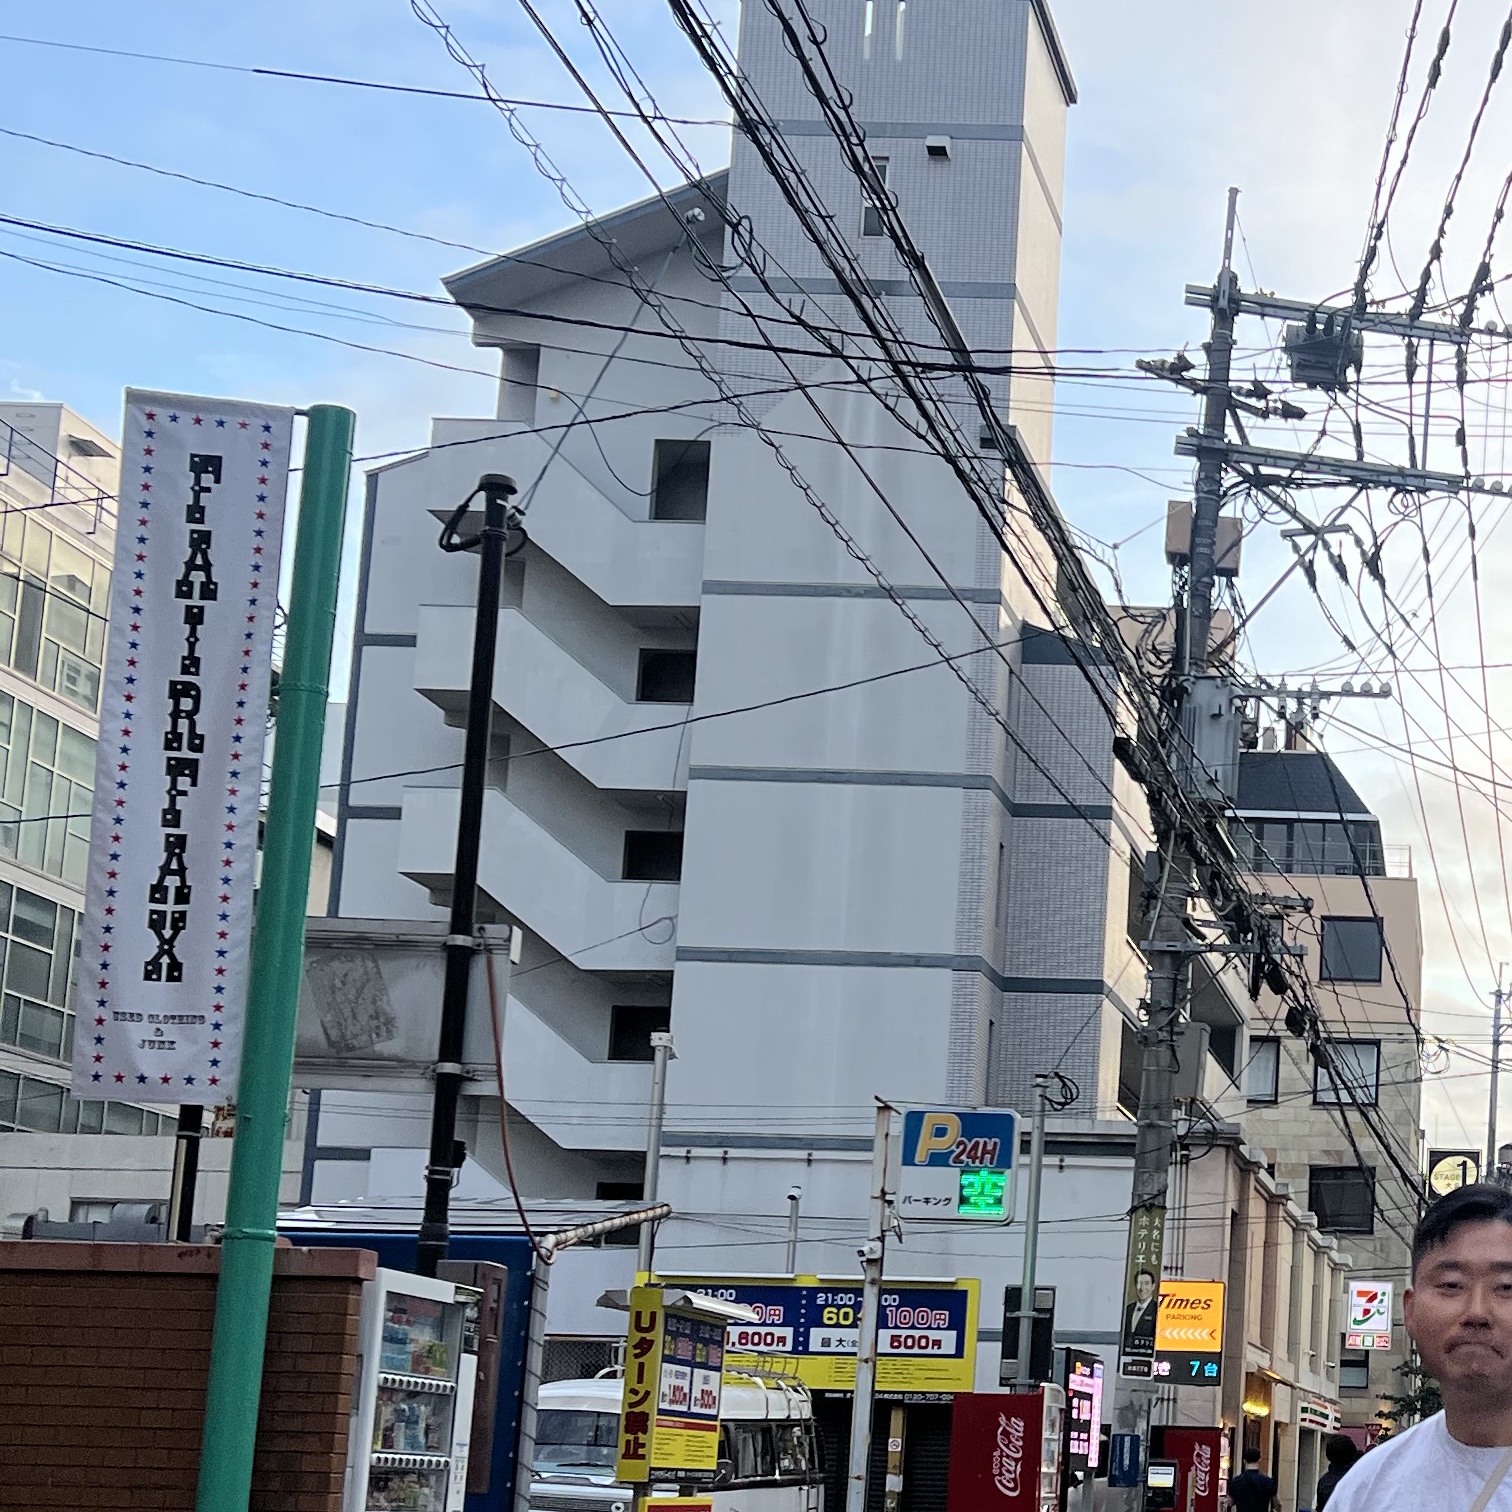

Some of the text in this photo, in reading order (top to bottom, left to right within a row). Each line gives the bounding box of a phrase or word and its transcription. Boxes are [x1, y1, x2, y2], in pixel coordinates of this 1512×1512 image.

[143, 452, 223, 983] FAIRFAX
[914, 1113, 1000, 1167] P 24H
[1135, 1215, 1150, 1264] ホテリエ
[1158, 1293, 1214, 1311] Times
[886, 1307, 950, 1329] 100円
[1165, 1313, 1204, 1322] PARKING
[889, 1334, 942, 1351] 500円
[1189, 1361, 1201, 1378] 7
[1203, 1362, 1219, 1378] 台
[621, 1310, 658, 1461] Uターン禁止
